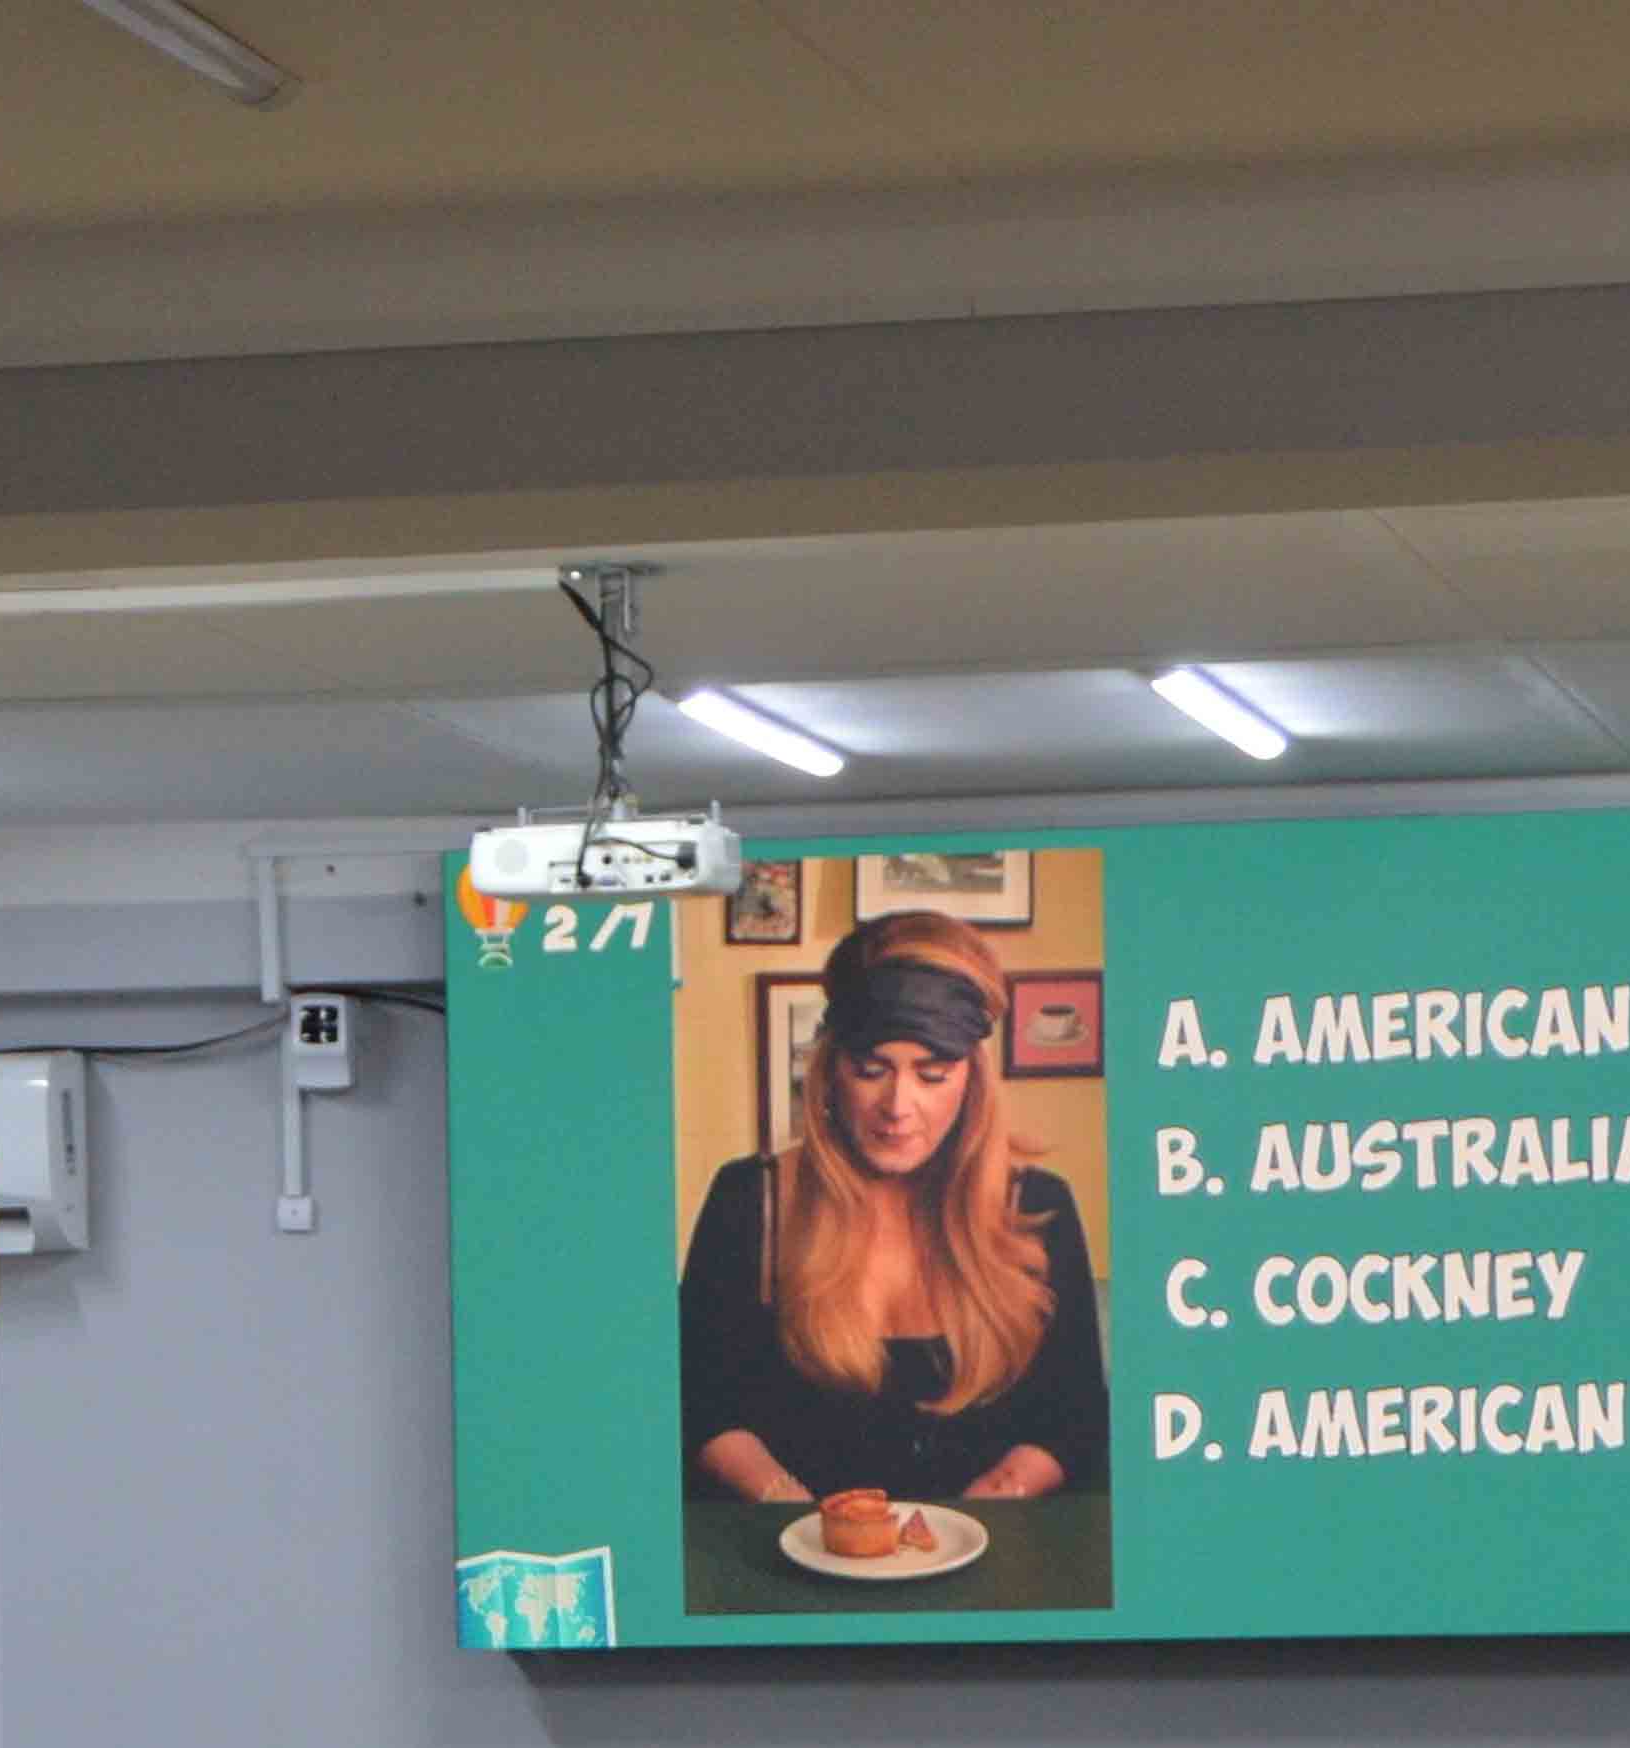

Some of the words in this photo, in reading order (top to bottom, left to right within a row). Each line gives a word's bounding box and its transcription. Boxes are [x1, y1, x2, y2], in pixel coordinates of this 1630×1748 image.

[1158, 997, 1228, 1068] A.
[1156, 1126, 1226, 1196] B.
[1165, 1257, 1228, 1328] C.
[1252, 1249, 1585, 1326] COCKNEY
[1152, 1392, 1223, 1461] D.
[1247, 1381, 1627, 1459] AMERICAN
